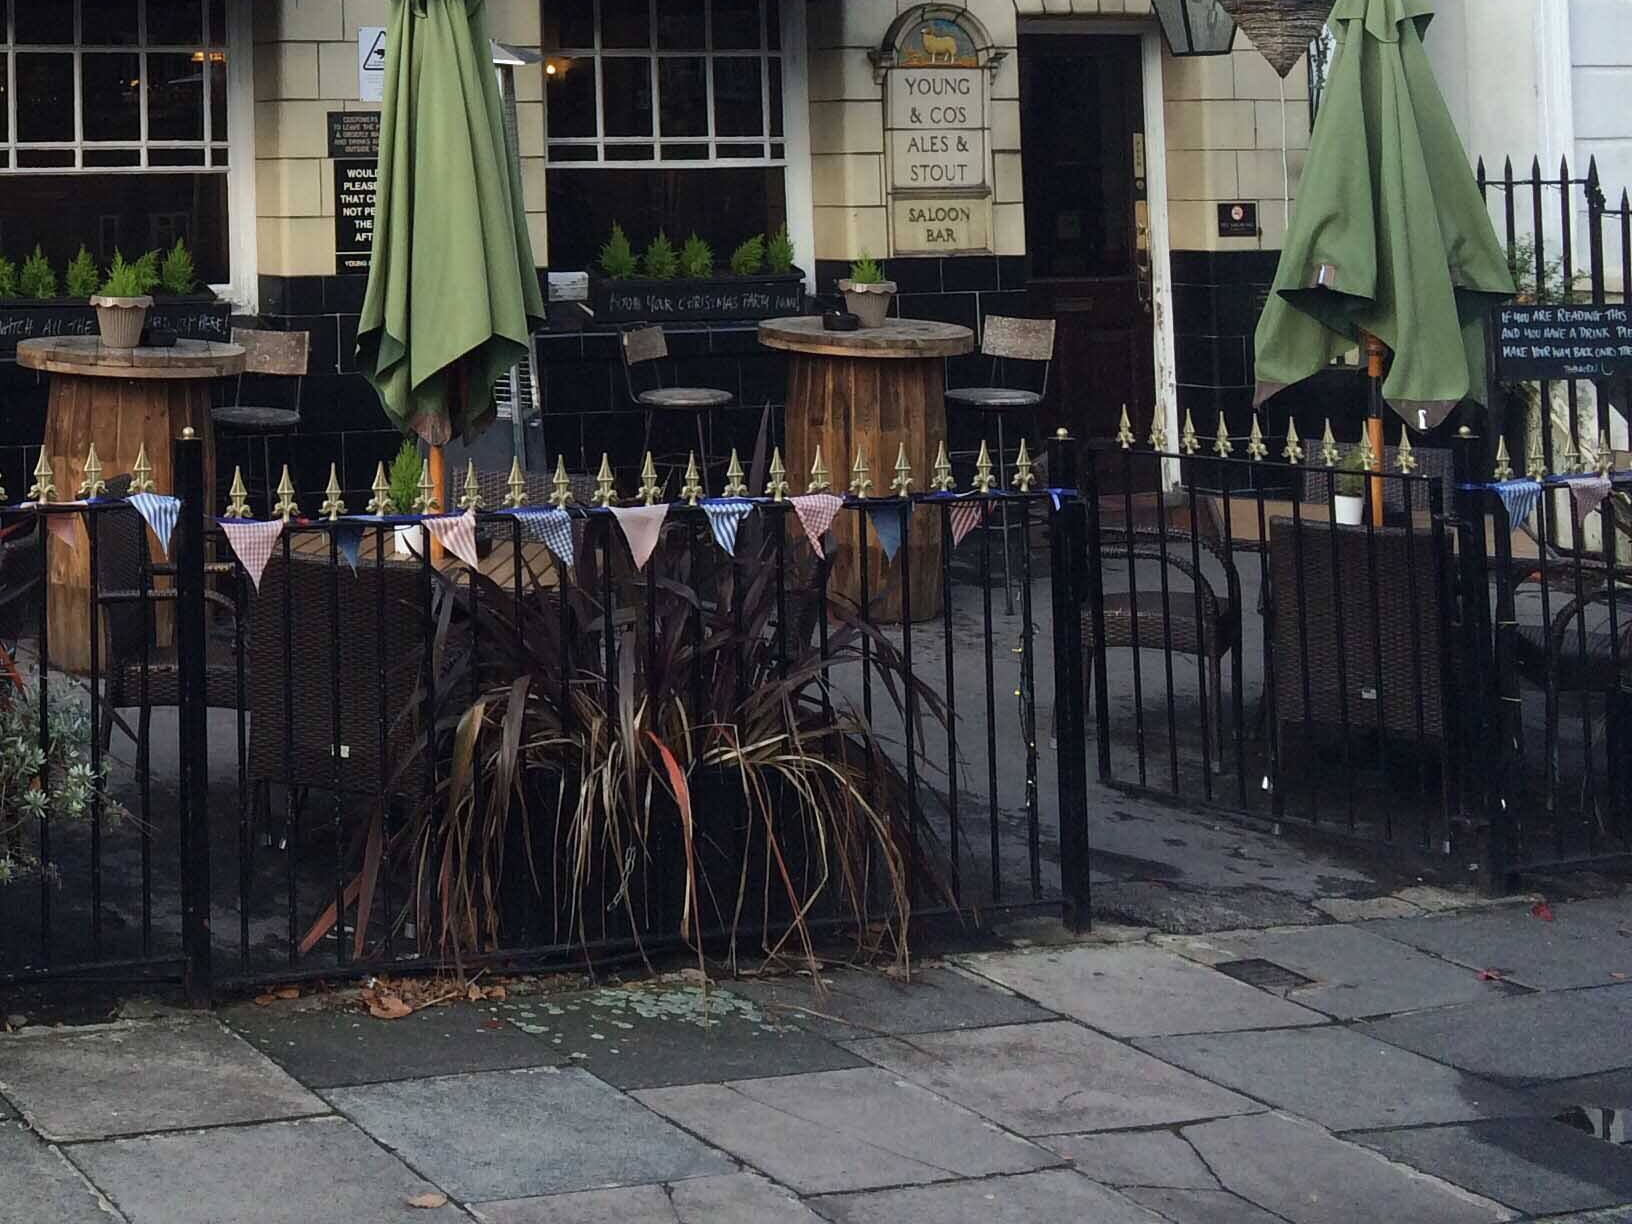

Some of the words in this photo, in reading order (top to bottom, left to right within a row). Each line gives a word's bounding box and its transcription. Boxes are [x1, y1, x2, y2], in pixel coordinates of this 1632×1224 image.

[904, 78, 971, 95] YOUNG
[910, 108, 922, 124] &
[907, 136, 949, 154] ALES
[956, 136, 969, 153] &
[910, 164, 968, 182] STOUT
[340, 194, 365, 204] THAT
[342, 207, 363, 217] NOT
[908, 207, 971, 223] SALOON
[354, 220, 373, 229] THE
[355, 233, 372, 242] AFT
[926, 228, 957, 243] BAR
[1501, 310, 1512, 323] IF
[1533, 310, 1553, 322] ARE
[1557, 308, 1602, 322] READING
[1604, 308, 1627, 322] THIS
[1501, 327, 1520, 340] AND
[1523, 327, 1541, 338] YOU
[1569, 327, 1577, 339] A
[1579, 326, 1610, 339] DRINK
